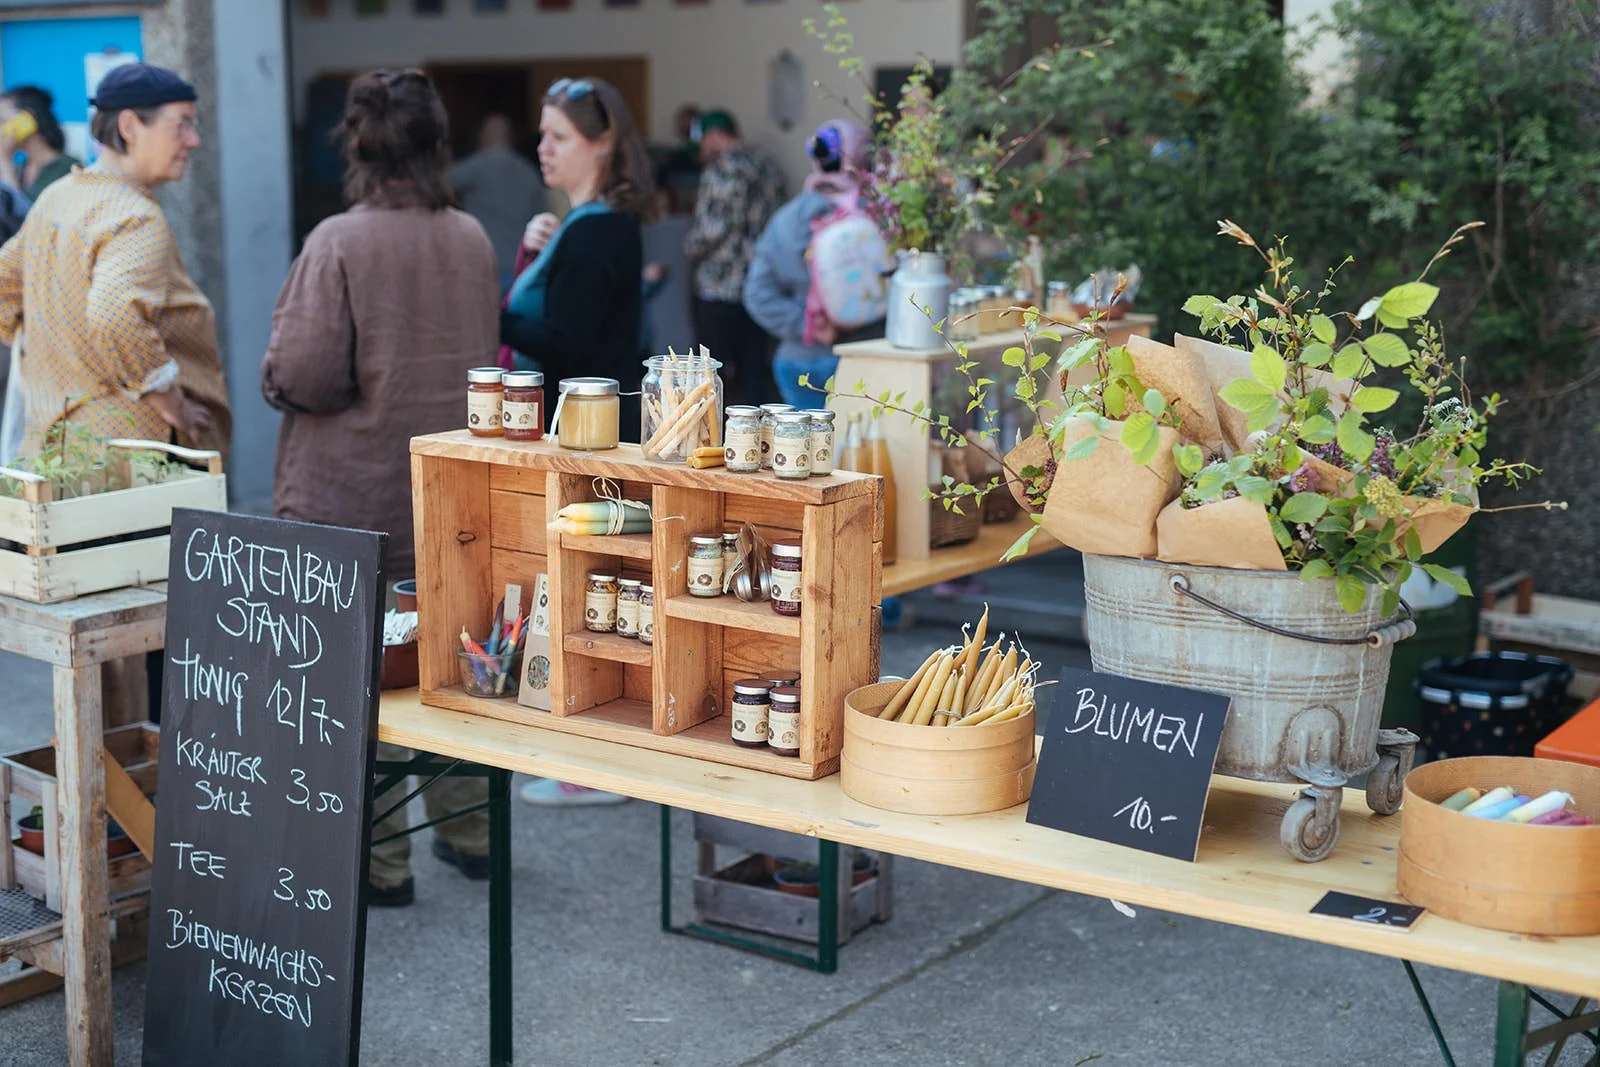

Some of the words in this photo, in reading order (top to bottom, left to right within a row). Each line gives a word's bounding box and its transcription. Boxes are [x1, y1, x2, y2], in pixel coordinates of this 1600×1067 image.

[185, 528, 358, 612] GARTENBAU
[217, 597, 323, 668] STAND
[1064, 687, 1205, 757] BLUMEN
[195, 781, 252, 817] SALZ
[170, 841, 227, 879] TEE
[208, 959, 312, 1028] KERZEN
